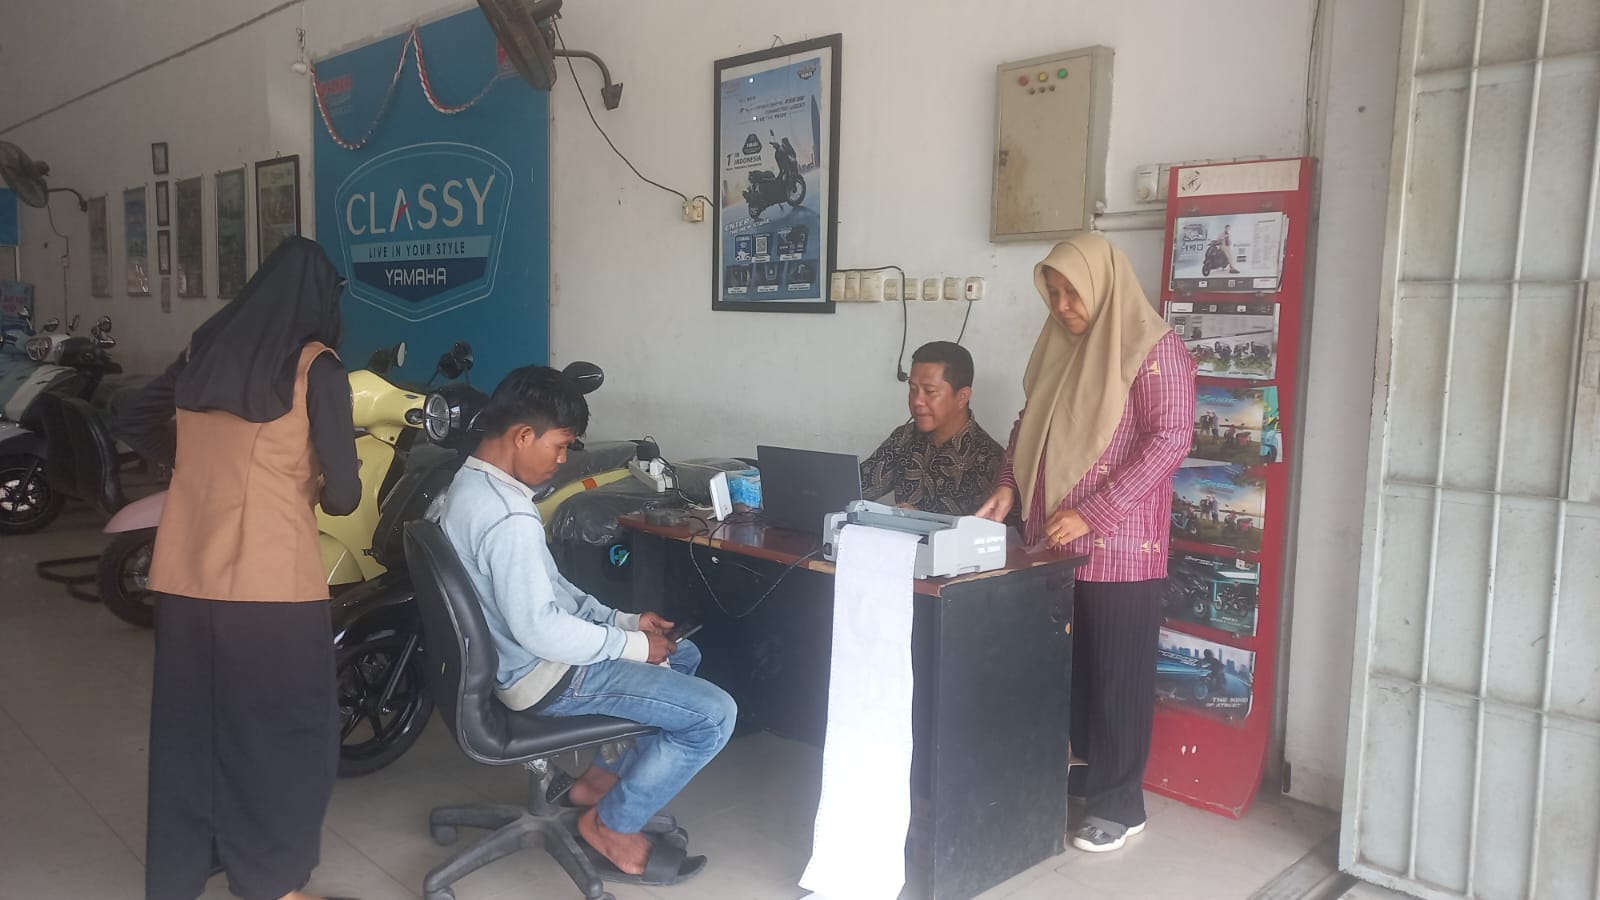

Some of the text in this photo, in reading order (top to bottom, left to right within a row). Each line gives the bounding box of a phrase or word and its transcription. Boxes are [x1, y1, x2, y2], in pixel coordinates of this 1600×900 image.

[346, 174, 495, 236] CLASSY
[369, 241, 465, 259] LIVE IN YOUR STYLE
[385, 267, 447, 287] YAMAHA
